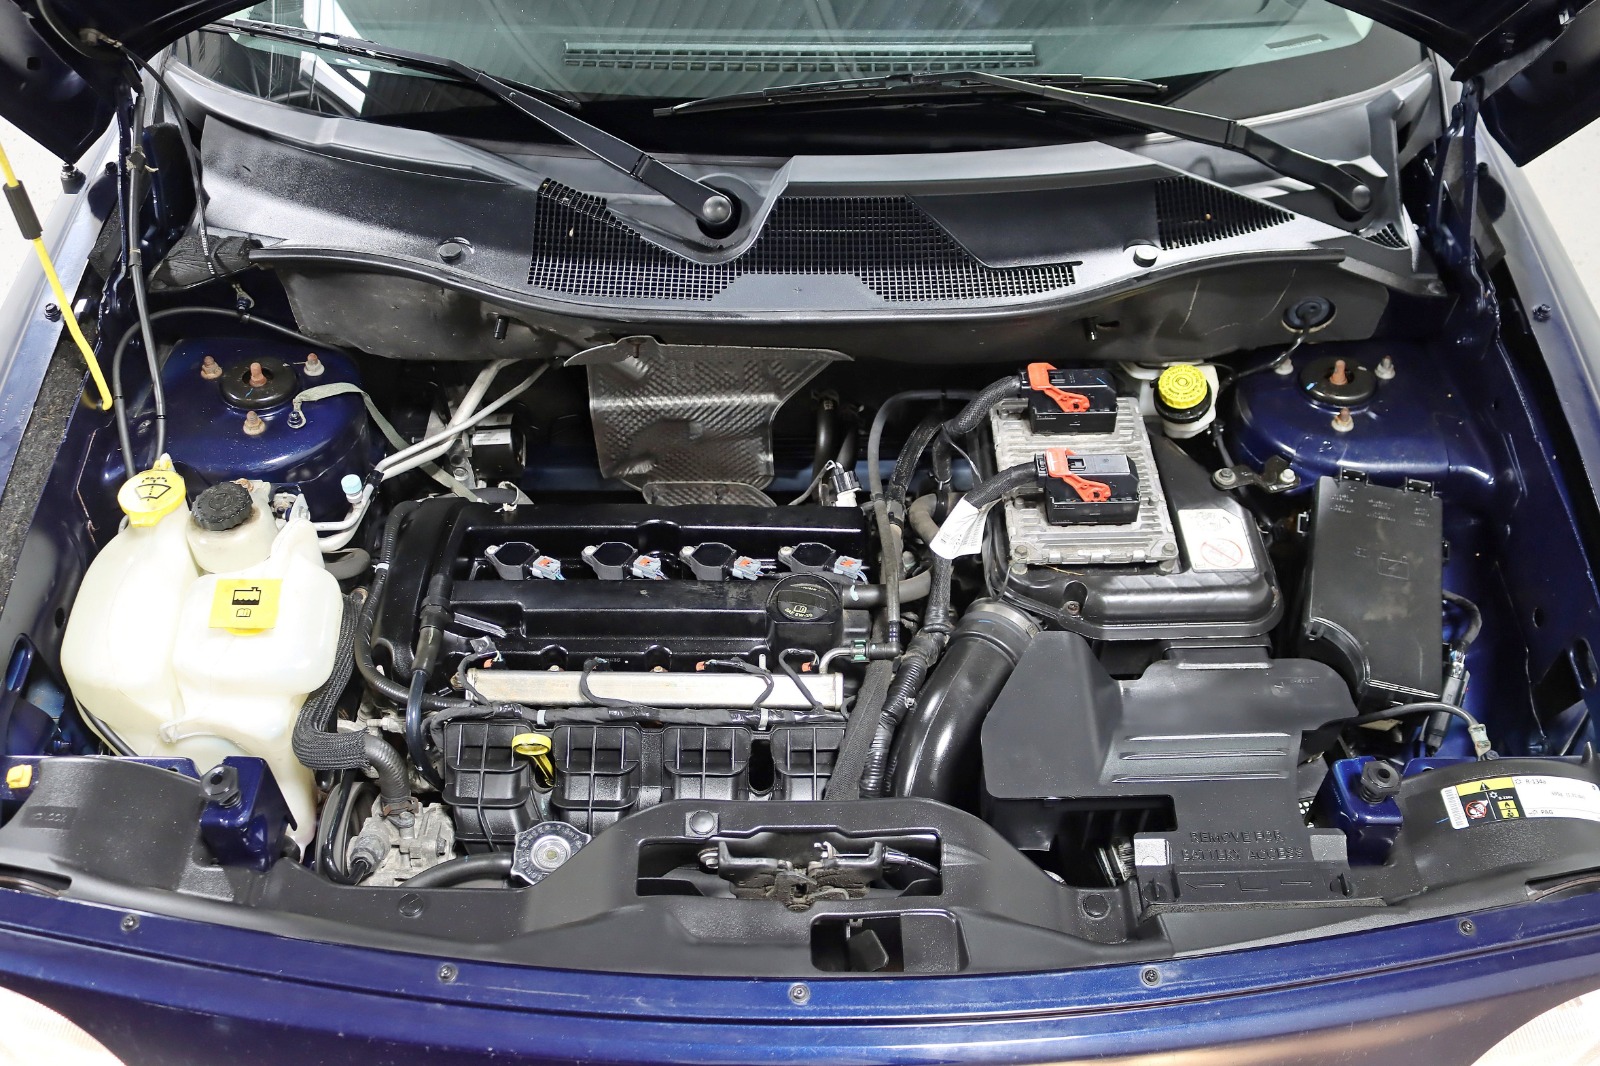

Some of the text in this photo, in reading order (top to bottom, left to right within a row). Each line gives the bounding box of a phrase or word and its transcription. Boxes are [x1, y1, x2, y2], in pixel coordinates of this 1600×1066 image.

[1190, 830, 1284, 843] REMOVE FOR
[1181, 847, 1304, 861] BATTERY ACCESS
